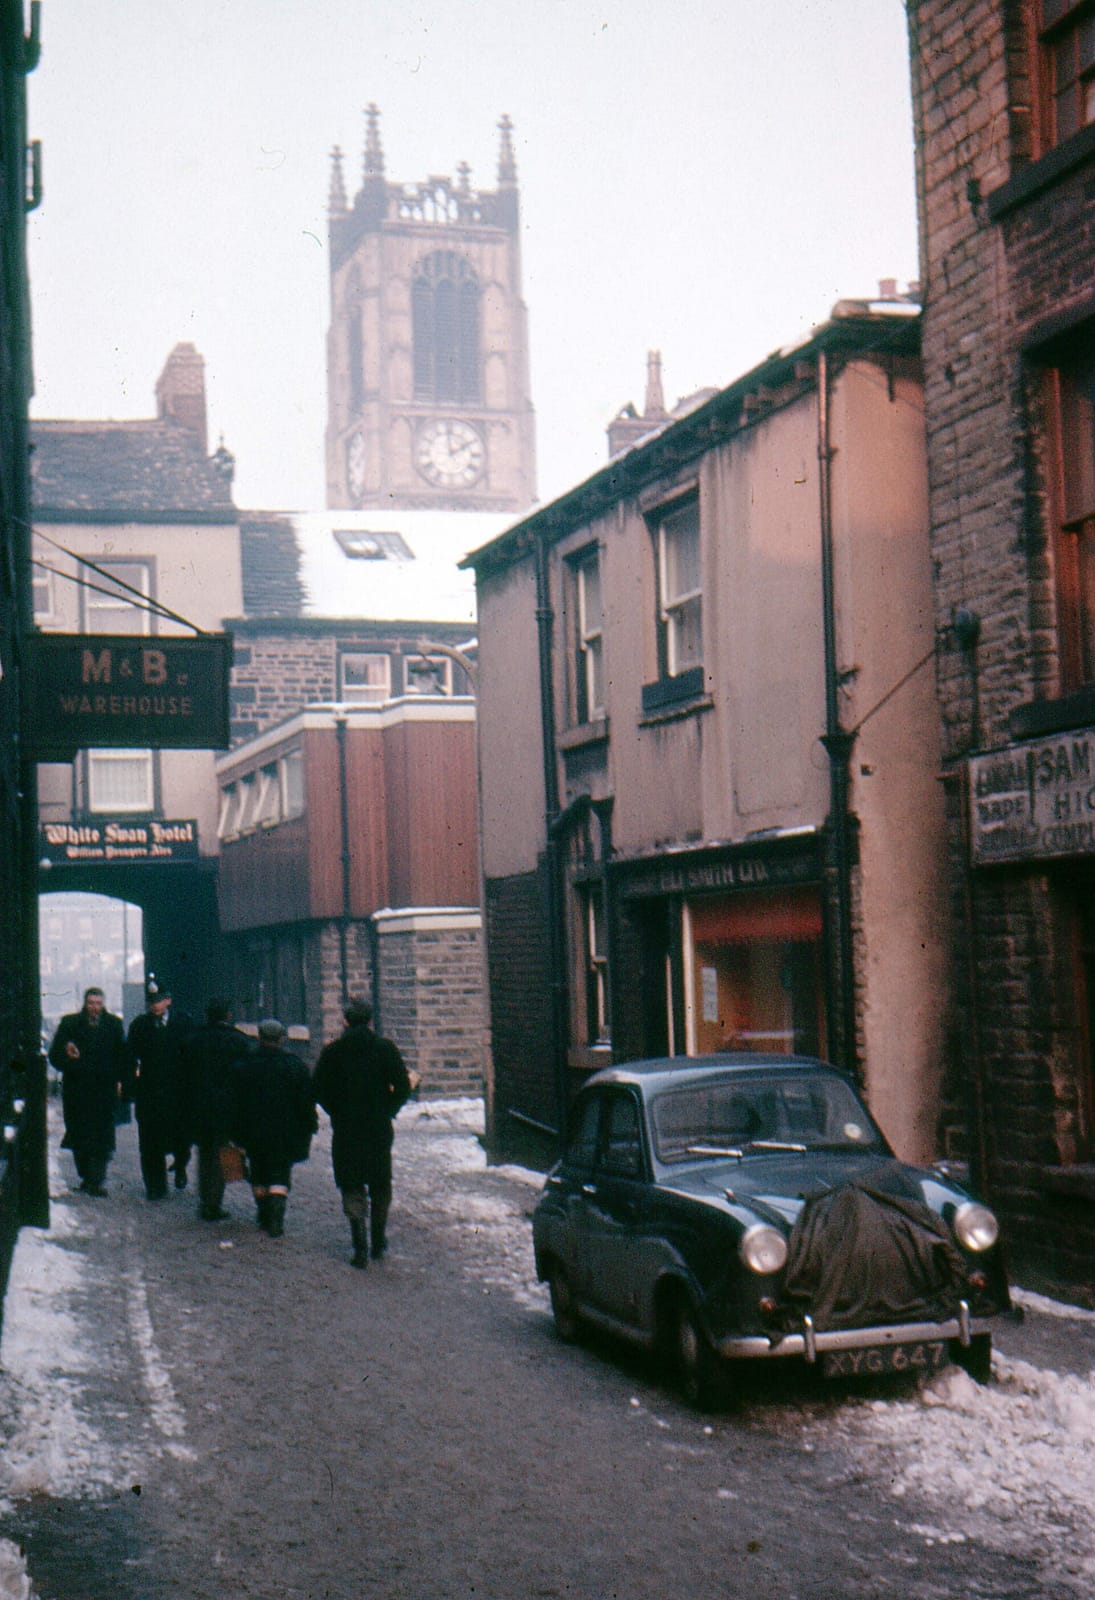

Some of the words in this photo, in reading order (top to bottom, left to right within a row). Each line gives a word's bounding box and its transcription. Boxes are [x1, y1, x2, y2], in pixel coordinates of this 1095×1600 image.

[81, 649, 112, 684] M
[119, 659, 133, 677] &
[143, 649, 168, 685] B
[60, 696, 194, 716] WAREHOUSE
[44, 823, 100, 845] White
[103, 823, 148, 844] Swan
[150, 822, 194, 844] Hotel
[828, 1350, 883, 1376] XYG
[892, 1342, 944, 1371] 647
